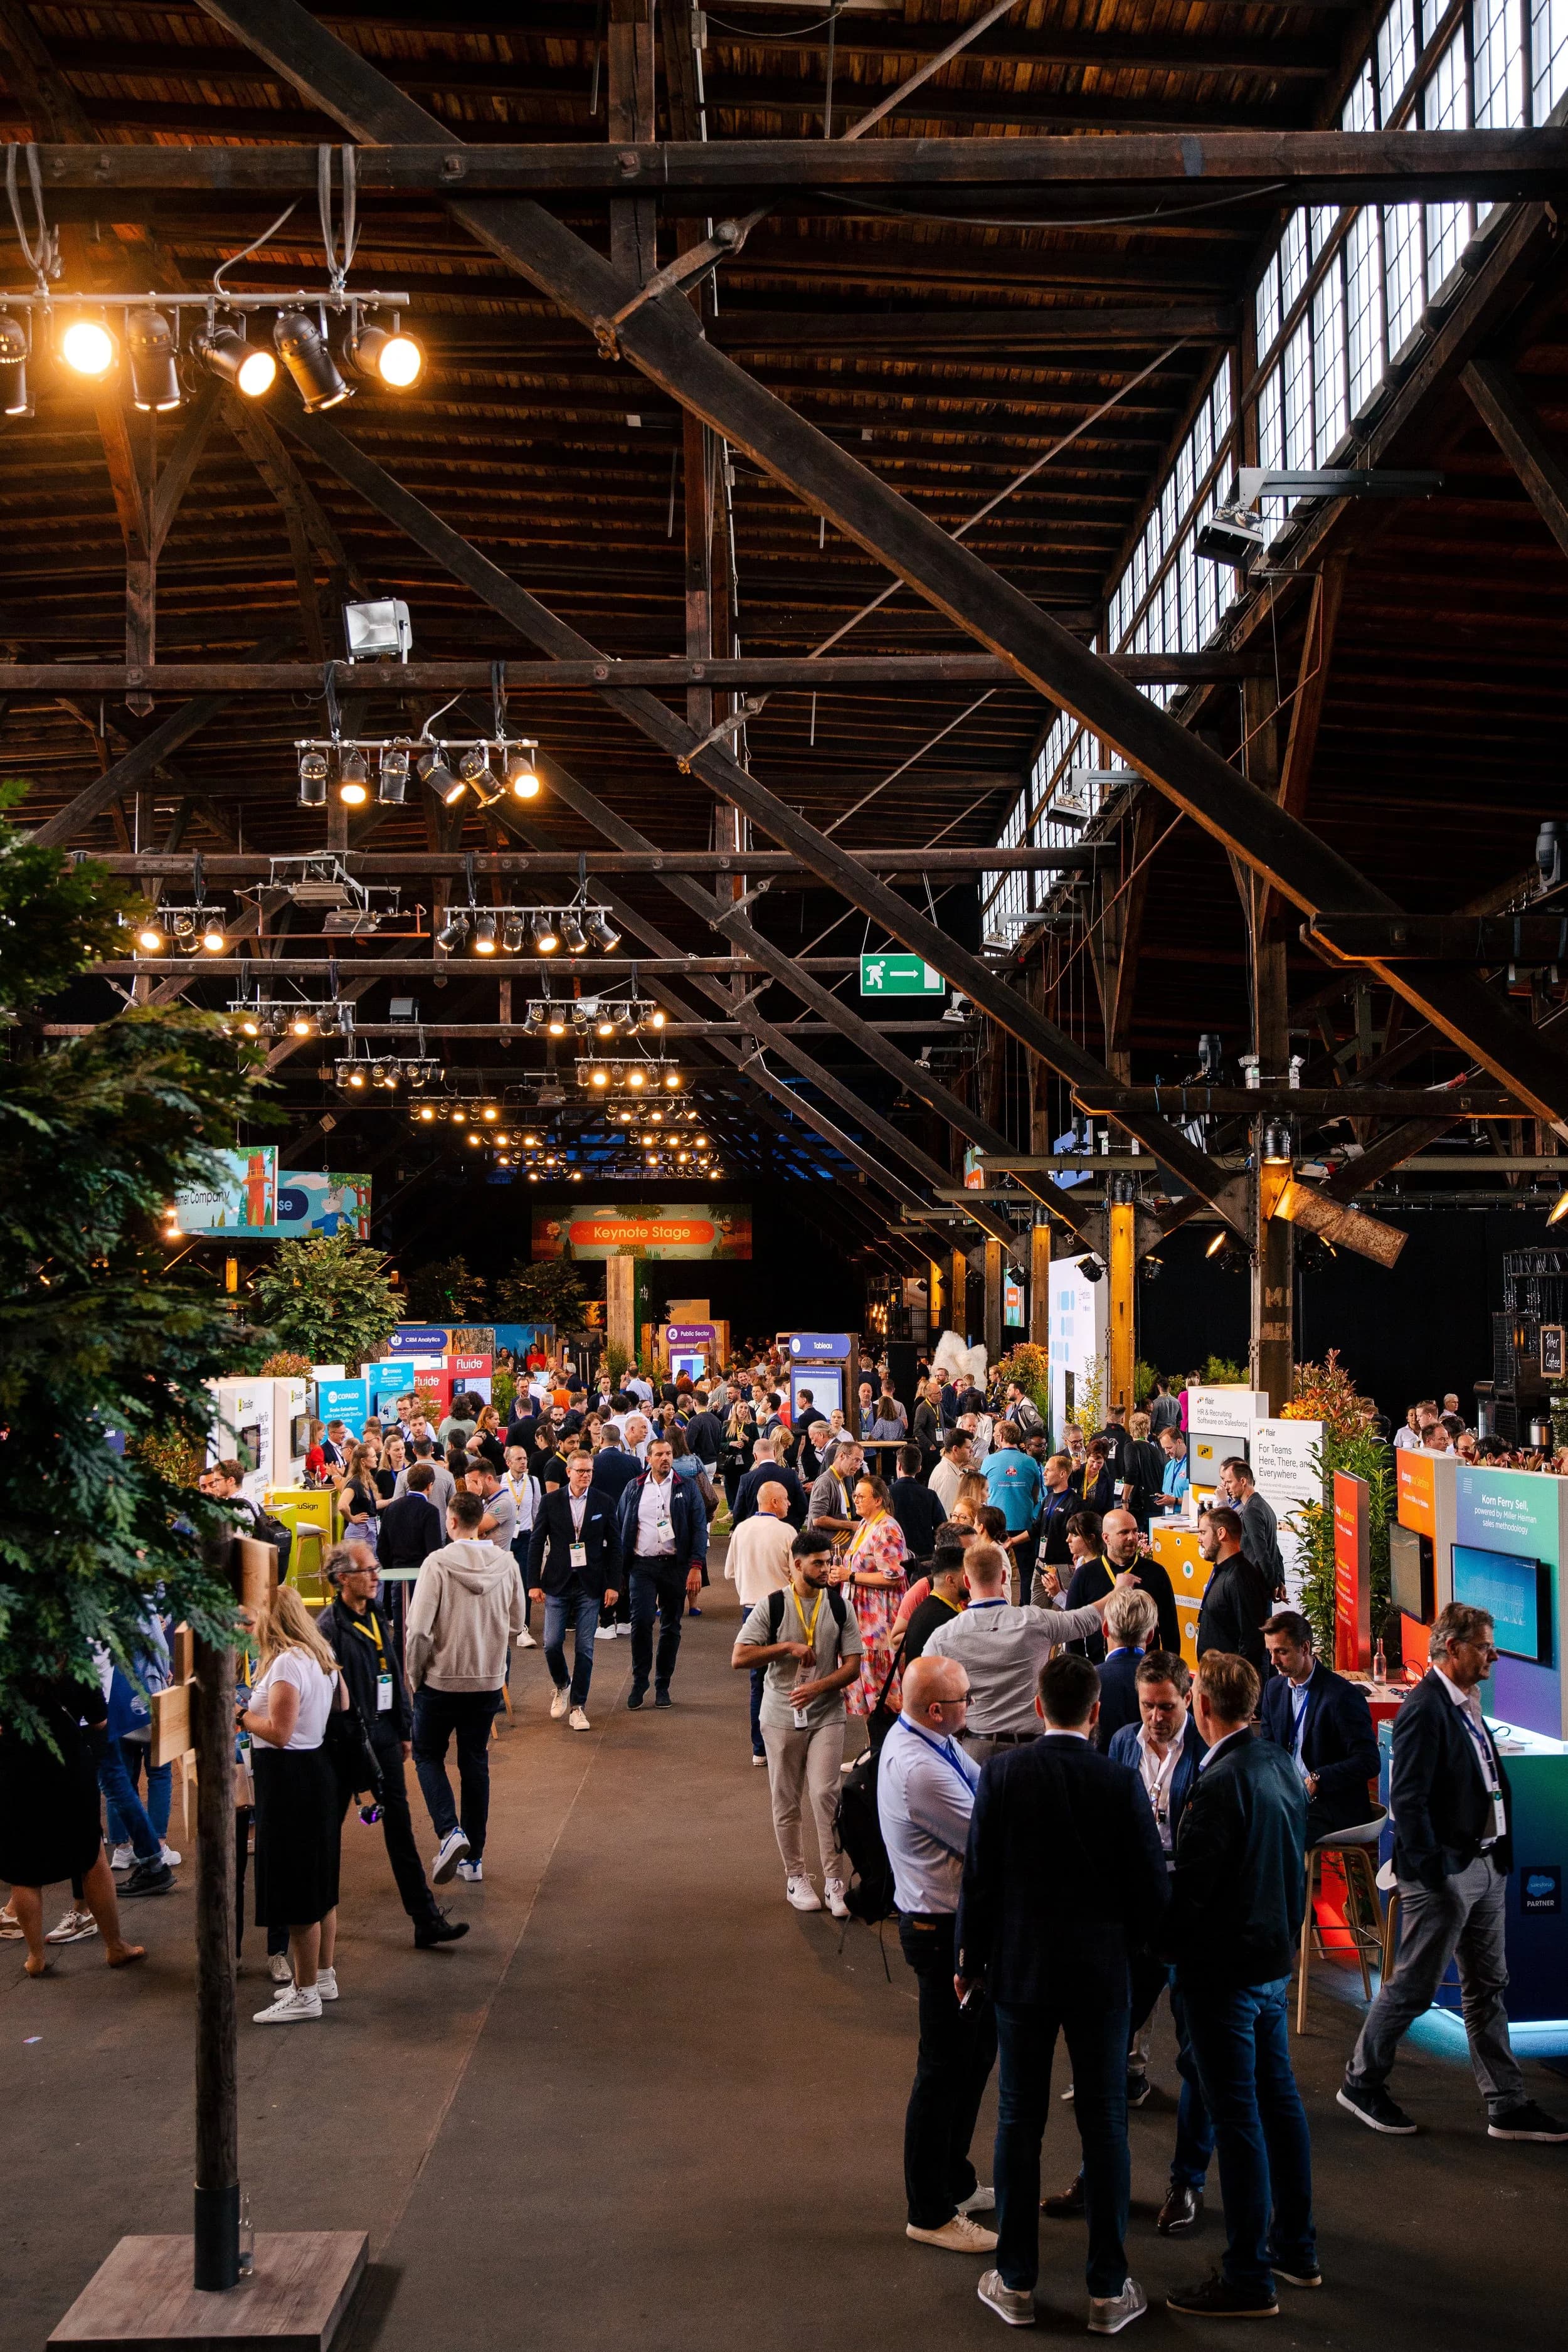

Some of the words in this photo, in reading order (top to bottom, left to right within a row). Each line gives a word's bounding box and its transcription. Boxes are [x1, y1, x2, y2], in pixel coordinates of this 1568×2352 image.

[190, 1189, 230, 1206] Company
[594, 1226, 649, 1241] Keynote
[652, 1226, 691, 1241] Stage
[813, 1342, 833, 1350] Tableau
[1545, 1332, 1559, 1348] Filter
[1545, 1352, 1560, 1370] Coffee
[1209, 1410, 1232, 1418] Recruiting
[1224, 1419, 1248, 1428] Salesforce
[1266, 1429, 1276, 1437] flair
[1259, 1444, 1269, 1453] For
[1271, 1444, 1292, 1454] Teams
[1259, 1456, 1276, 1468] Here,
[1278, 1458, 1298, 1470] There,
[1300, 1459, 1312, 1468] and
[1259, 1468, 1297, 1480] Everywhere
[297, 1503, 318, 1511] uSign
[1482, 1494, 1496, 1505] Korn
[1498, 1496, 1513, 1510] Ferry
[1515, 1500, 1528, 1512] Sell,
[1475, 1507, 1495, 1517] powered
[1496, 1509, 1502, 1519] by
[1503, 1510, 1517, 1520] Miller
[1517, 1513, 1537, 1523] Heiman
[1482, 1518, 1495, 1528] sales
[1495, 1520, 1528, 1535] methodology
